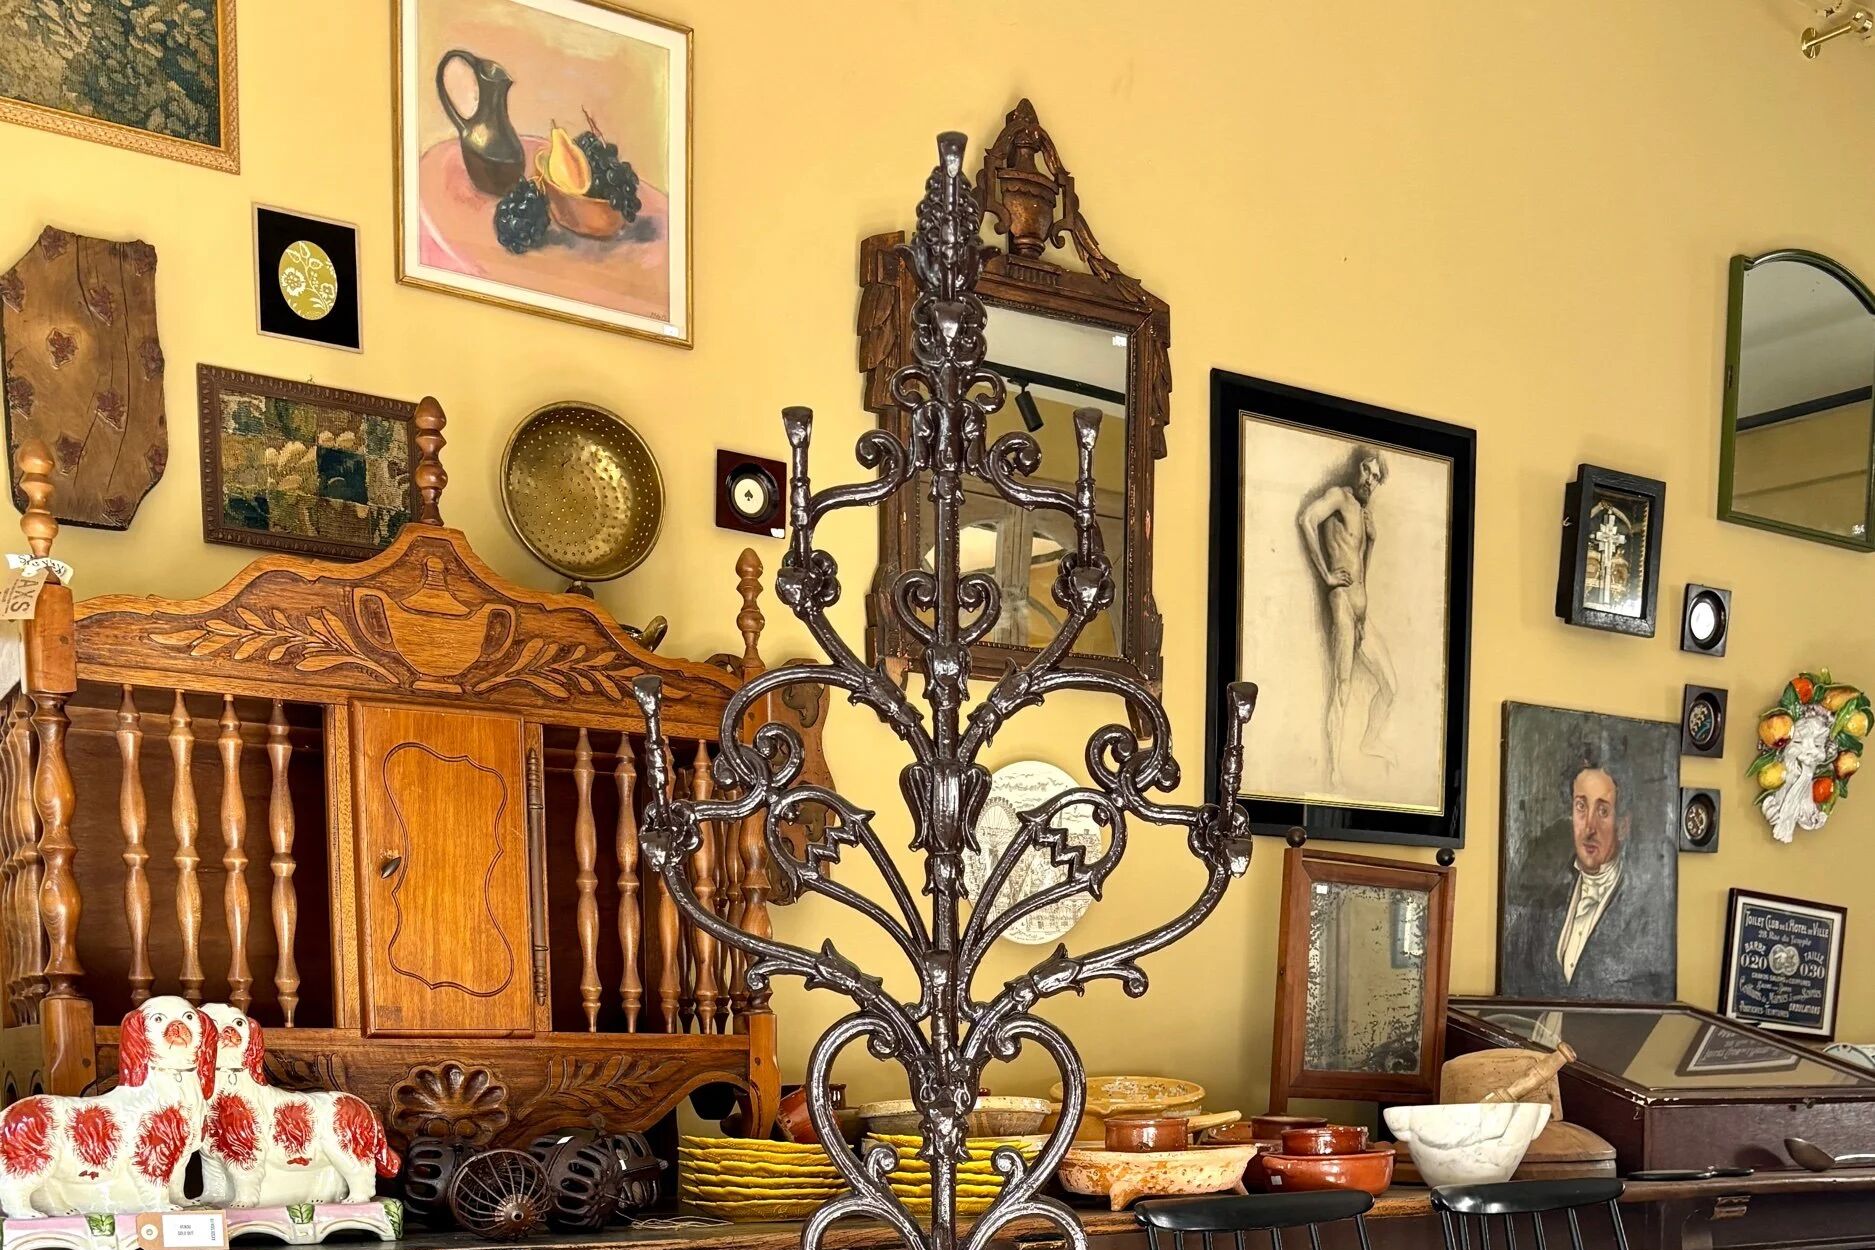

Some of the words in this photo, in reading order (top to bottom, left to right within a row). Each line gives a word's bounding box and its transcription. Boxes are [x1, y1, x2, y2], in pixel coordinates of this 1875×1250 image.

[10, 579, 39, 613] AXS
[1812, 922, 1829, 938] VILLE
[1803, 951, 1825, 965] TAILLE
